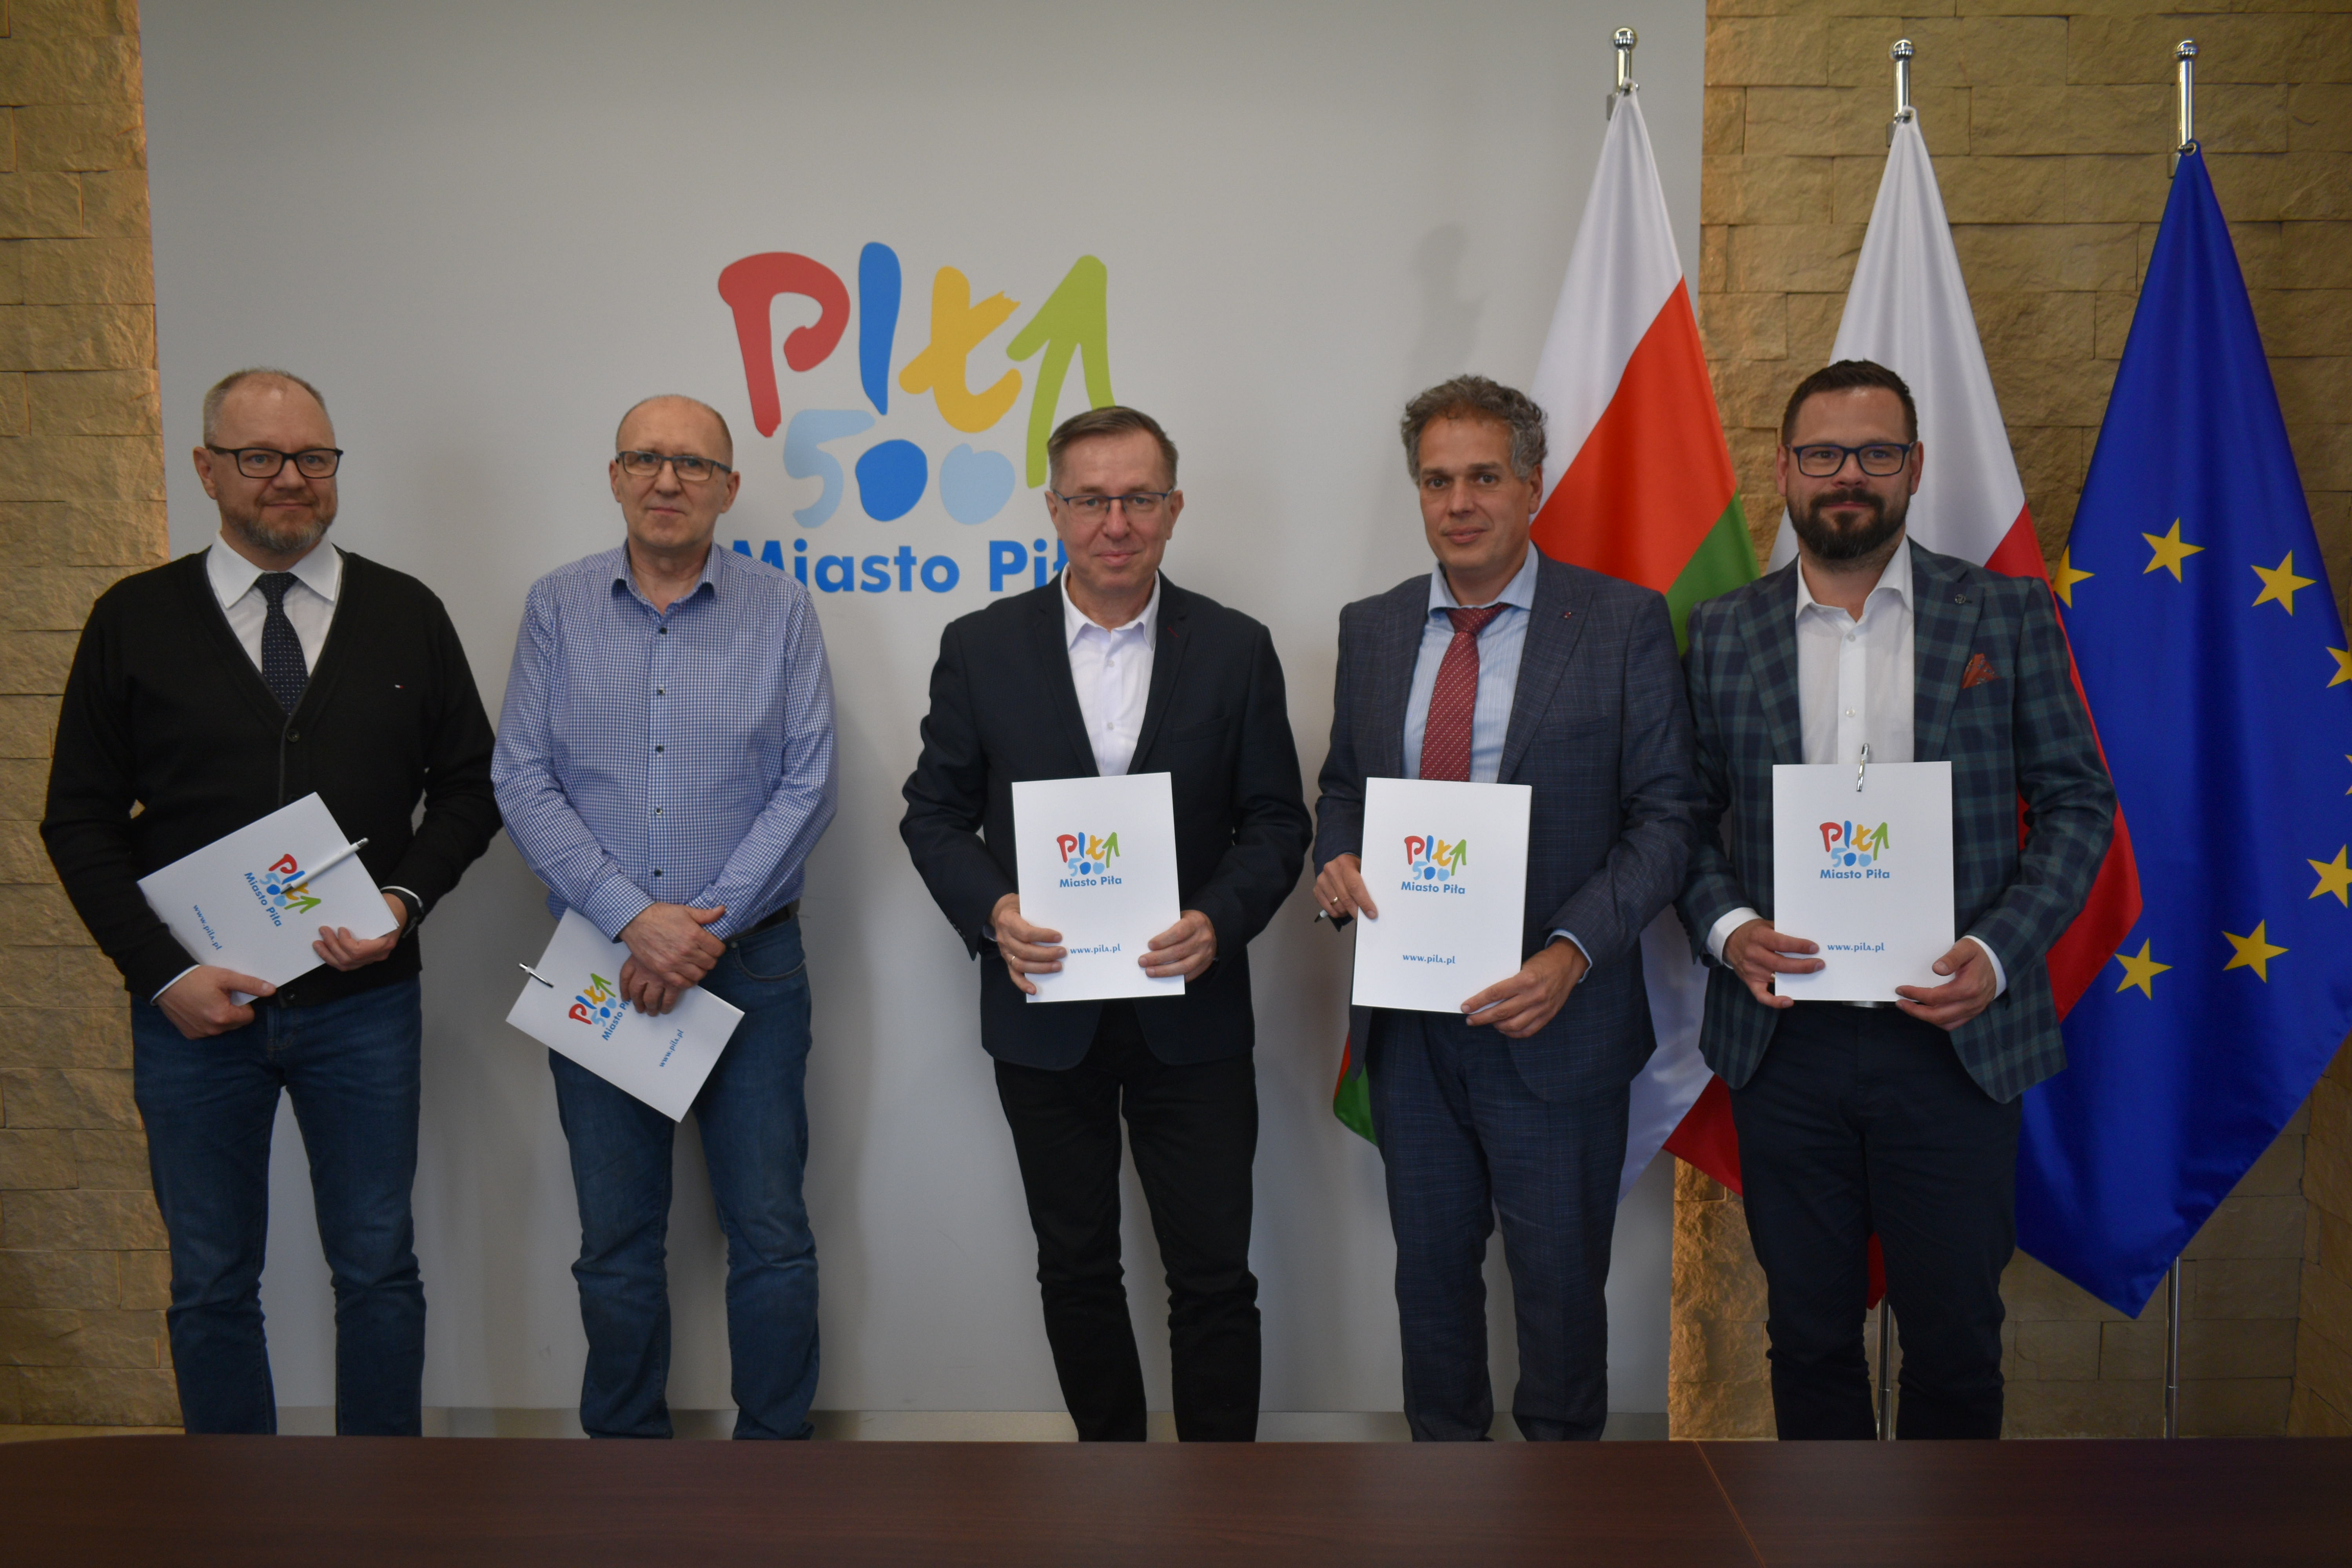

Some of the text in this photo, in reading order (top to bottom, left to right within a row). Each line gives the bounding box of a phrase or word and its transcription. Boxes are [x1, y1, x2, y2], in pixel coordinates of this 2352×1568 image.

[784, 409, 1015, 528] 500
[989, 538, 1069, 592] Pi
[1068, 857, 1105, 877] 500
[1831, 848, 1873, 867] 500
[1059, 876, 1122, 888] Miasto Piła
[1412, 861, 1451, 882] 500
[1820, 869, 1891, 879] Miasto Piła
[244, 872, 282, 927] Miasto Piła
[259, 872, 287, 907] 500
[1401, 881, 1466, 895] Miasto Piła
[591, 998, 617, 1027] 500
[602, 997, 632, 1041] Miasto Pi
